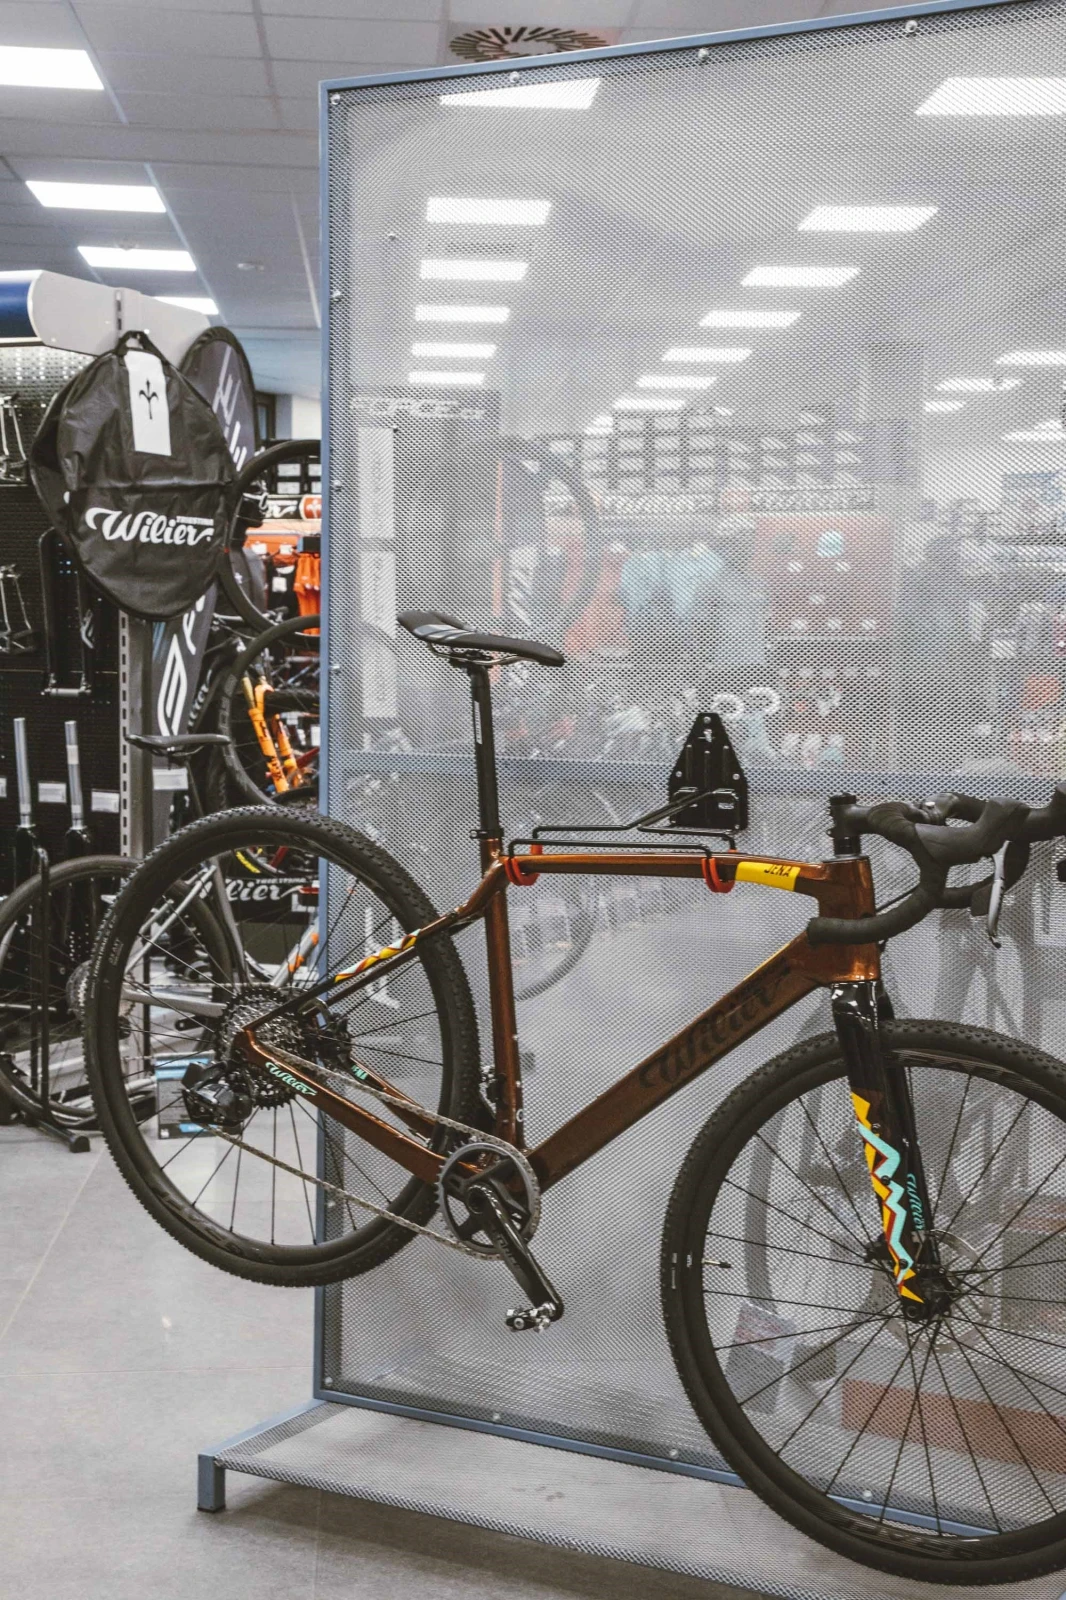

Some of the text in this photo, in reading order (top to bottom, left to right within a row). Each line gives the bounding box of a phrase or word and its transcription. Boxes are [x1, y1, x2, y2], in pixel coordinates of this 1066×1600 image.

[84, 507, 216, 546] Wilier
[763, 863, 792, 878] JENA
[265, 1061, 318, 1097] Wilier
